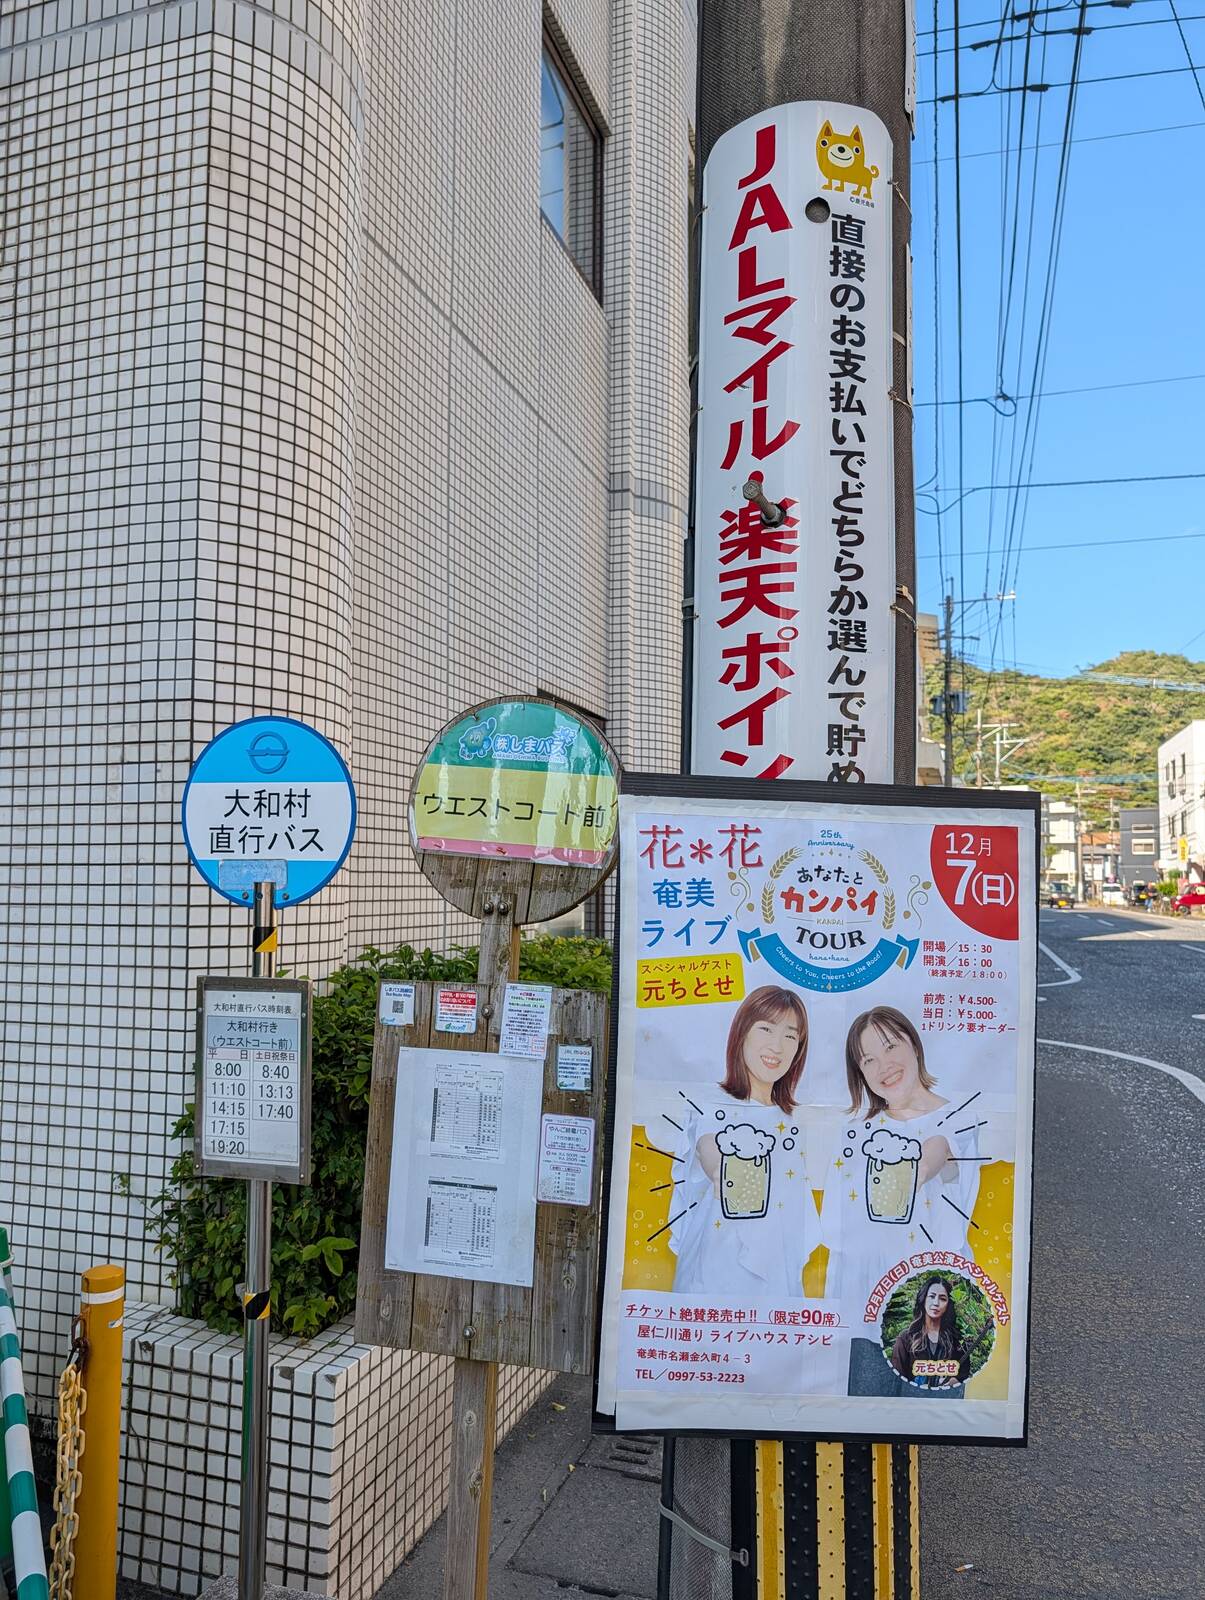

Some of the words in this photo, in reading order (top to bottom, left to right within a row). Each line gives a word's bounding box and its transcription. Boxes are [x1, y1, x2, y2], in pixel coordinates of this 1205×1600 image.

[224, 788, 311, 818] 大和村
[423, 793, 606, 828] ウエストコート前
[209, 824, 324, 854] 直行バス
[820, 829, 842, 838] 25th
[808, 839, 855, 850] Anniversary
[945, 832, 991, 857] 12月
[797, 865, 864, 885] あなたと
[946, 858, 1015, 907] 7(日)
[652, 877, 715, 909] 奄美
[780, 886, 878, 916] カンパイ
[816, 918, 844, 926] KANPAI
[641, 914, 733, 947] ライブ
[796, 926, 866, 950] TOUR
[641, 958, 733, 974] スペシャルゲスト
[775, 946, 794, 966] Cheers
[795, 964, 803, 972] to
[822, 972, 846, 980] Cheers
[855, 965, 866, 975] the
[643, 975, 734, 1002] 元ちとせ
[214, 1003, 292, 1014] 大和村直行バス時刻表
[227, 1020, 278, 1033] 大和村行き
[921, 1021, 1016, 1034] 1ドリンク要オーダー
[212, 1035, 293, 1050] (ウエストコート前)
[255, 1051, 295, 1061] 土日祝祭日
[214, 1063, 242, 1076] 8:00
[262, 1065, 290, 1079] 8:40
[212, 1082, 245, 1096] 11:10
[258, 1084, 293, 1099] 13:13
[212, 1102, 245, 1116] 14:15
[258, 1104, 293, 1119] 17:40
[211, 1120, 245, 1135] 17:15
[211, 1139, 245, 1155] 19:20
[637, 1325, 703, 1343] 屋仁川通り
[709, 1329, 788, 1345] ライブハウス
[794, 1334, 833, 1346] アシビ
[915, 1362, 957, 1373] 元ちとせ
